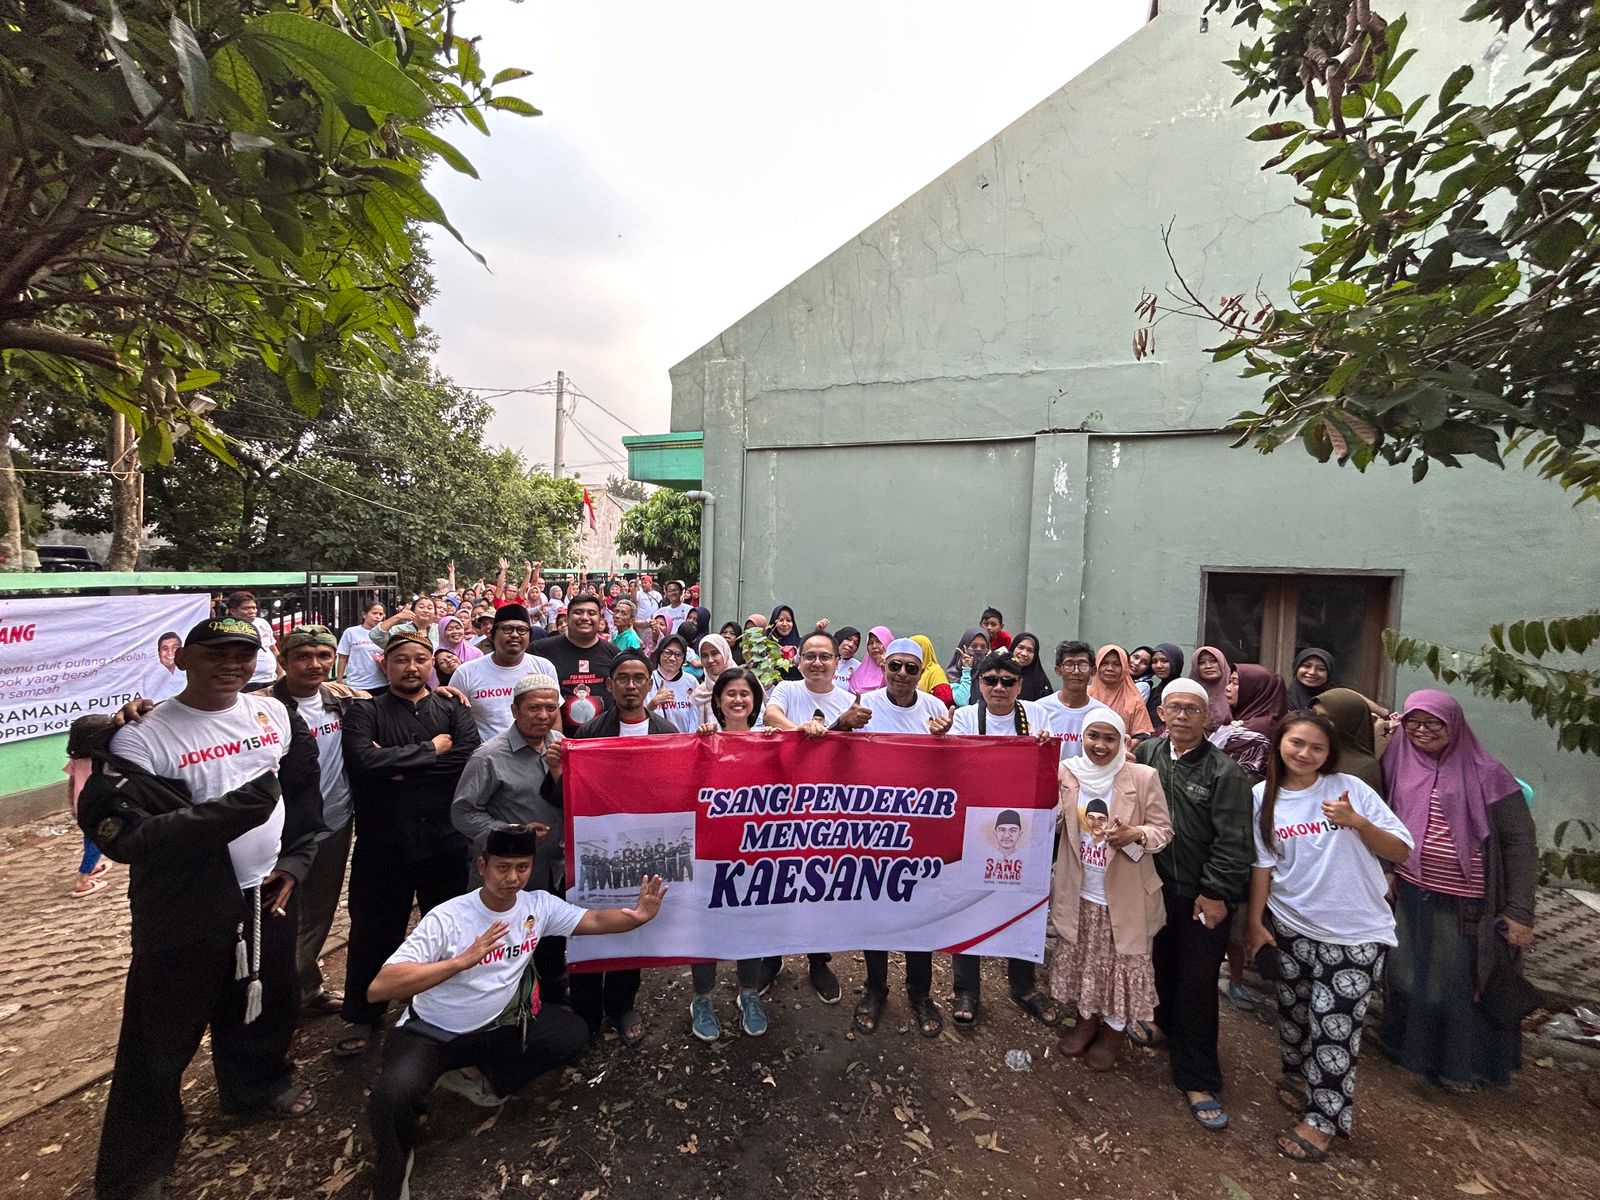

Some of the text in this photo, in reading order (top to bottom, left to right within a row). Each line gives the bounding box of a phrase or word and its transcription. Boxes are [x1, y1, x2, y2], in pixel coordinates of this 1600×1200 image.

[37, 661, 62, 671] duit
[65, 657, 107, 669] pulang
[109, 652, 147, 664] sekolah
[26, 674, 59, 686] yang
[62, 669, 98, 681] bersih
[9, 684, 61, 699] sampah
[88, 692, 142, 709] PUTRA
[475, 687, 515, 699] JOKOW
[178, 732, 280, 769] JOKOW15ME
[700, 784, 956, 817] "SANG PENDEKAR
[741, 820, 913, 851] MENGAWAL
[986, 858, 1023, 873] SANG
[707, 856, 943, 909] KAESANG”
